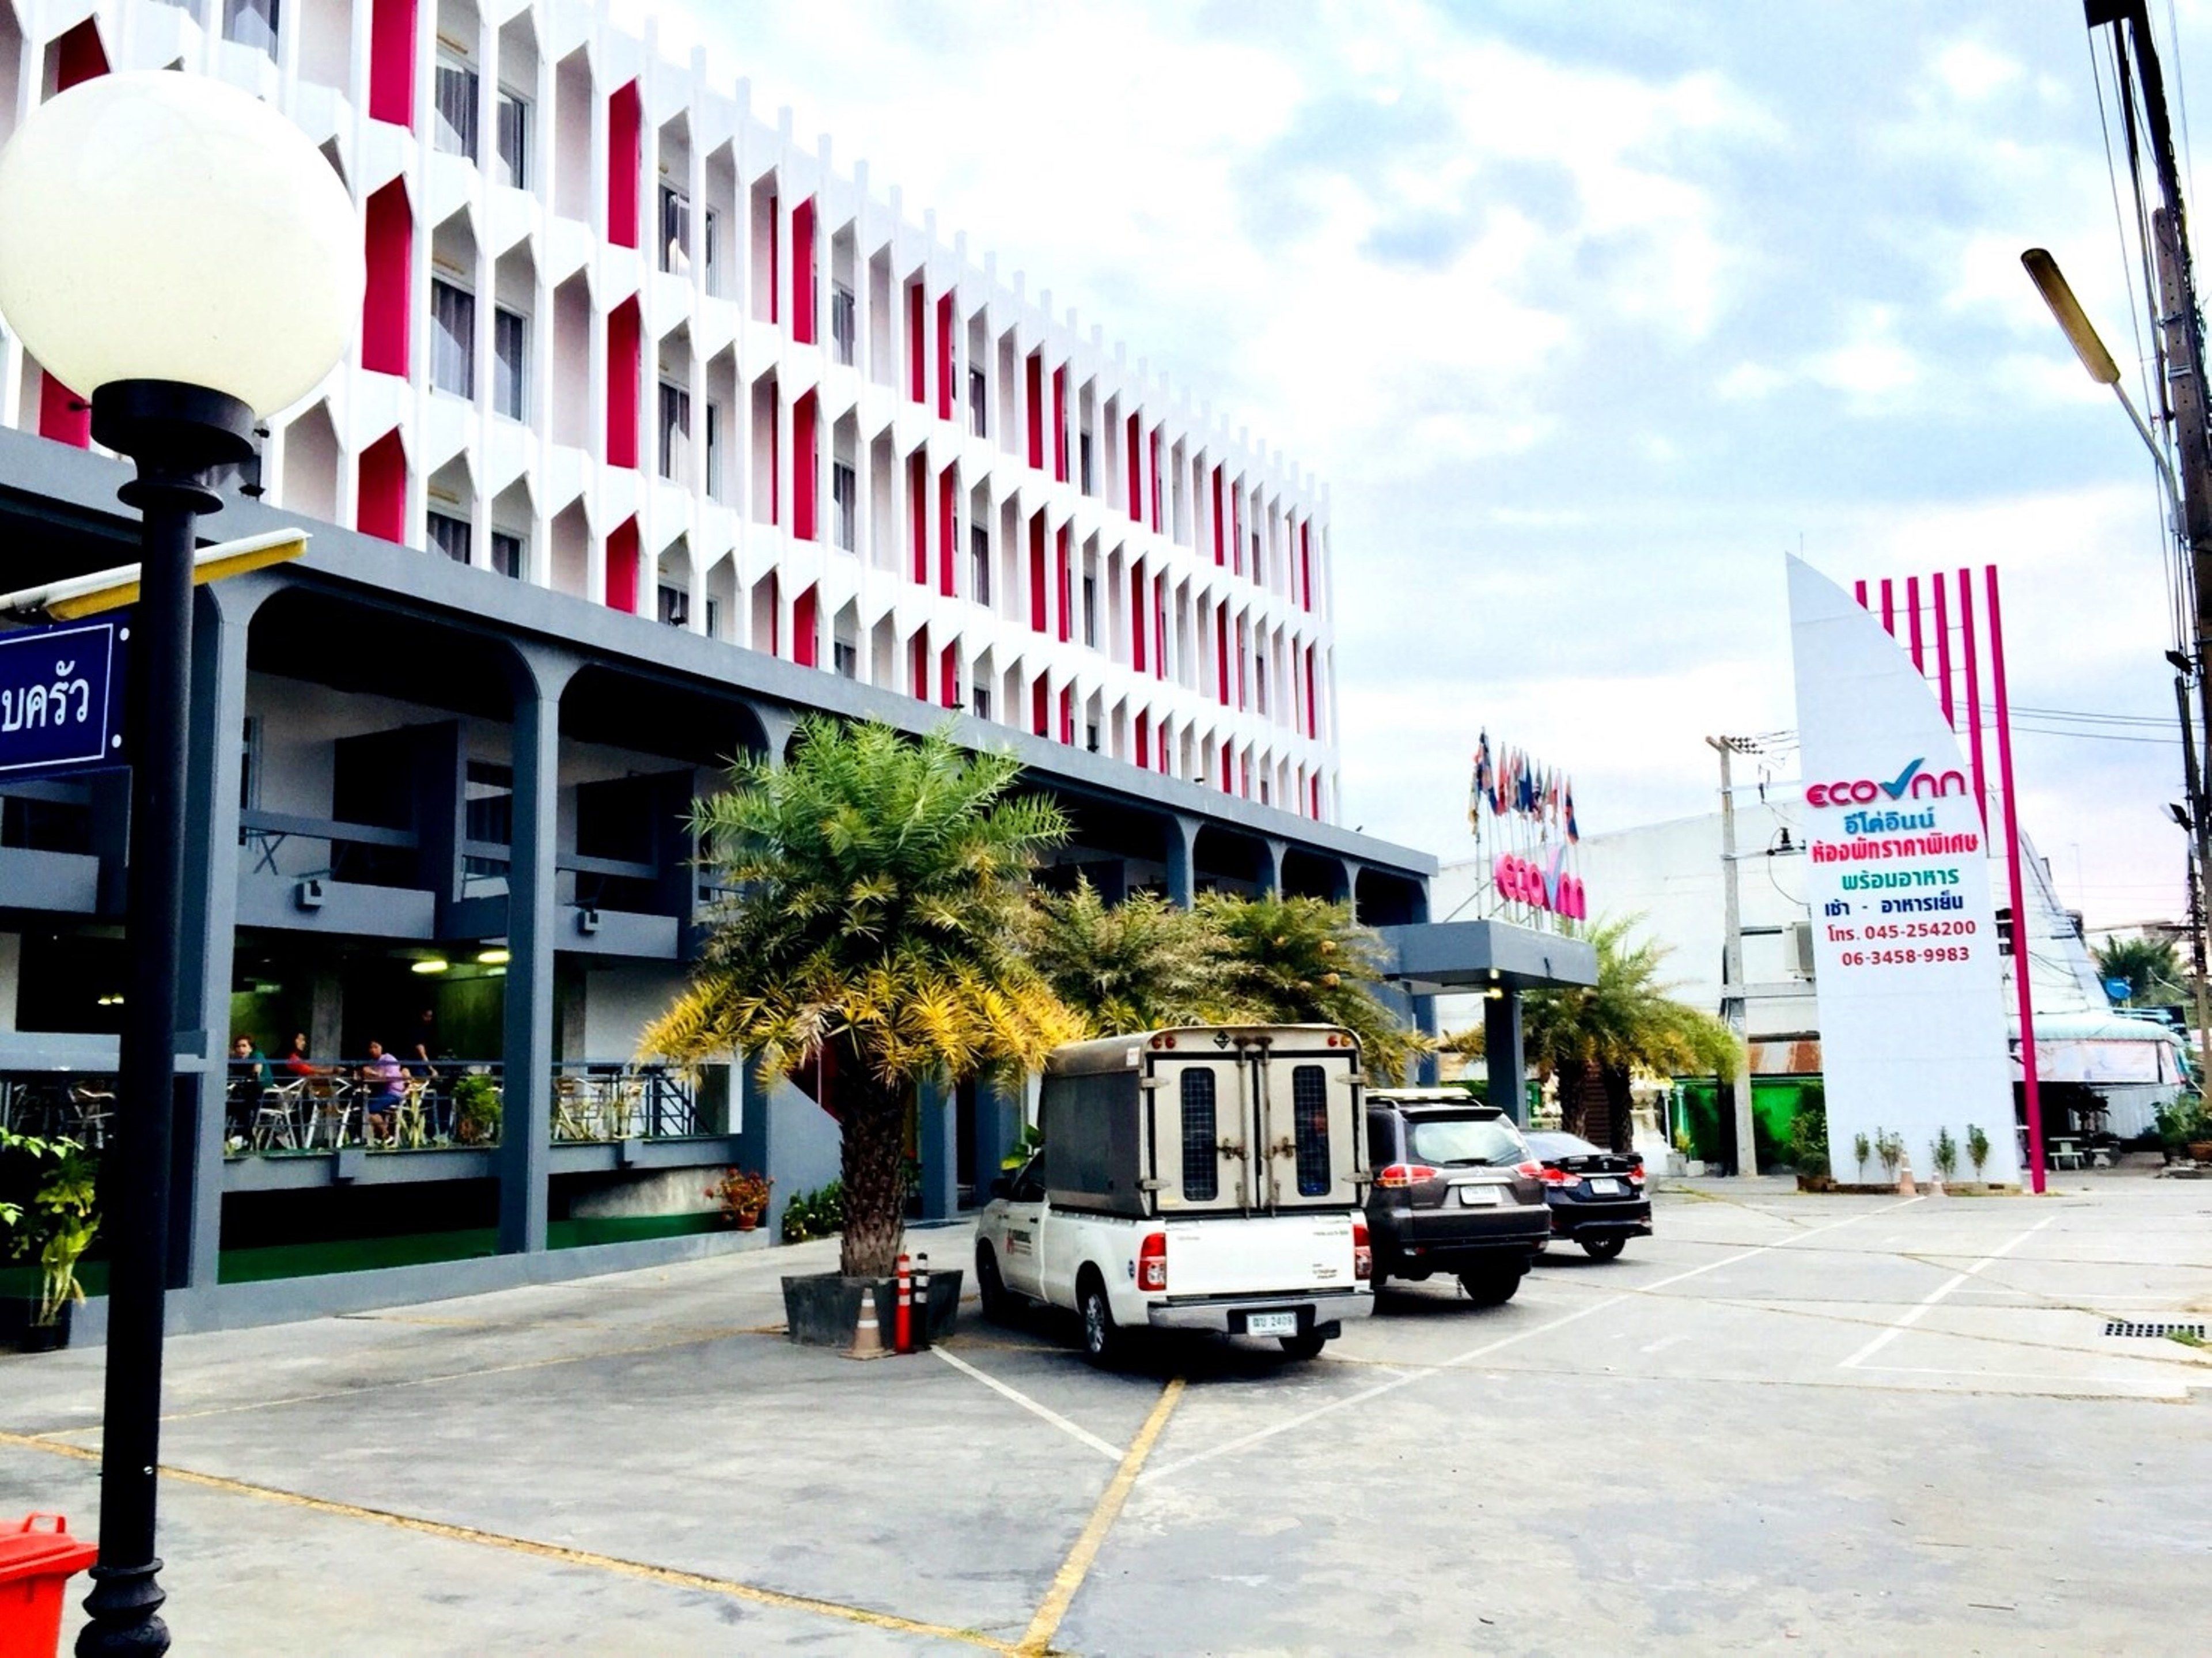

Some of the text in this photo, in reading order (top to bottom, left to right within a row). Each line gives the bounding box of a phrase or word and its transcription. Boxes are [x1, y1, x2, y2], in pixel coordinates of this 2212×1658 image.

[1813, 832, 1978, 862] ห้องพักราคาพิเศษ
[1842, 869, 1959, 890] พร้อมอาหาร
[1825, 899, 1850, 916] เช้า
[1881, 890, 1963, 913] อาหารเย็น
[1827, 921, 1976, 941] โทร. 045-254200
[1842, 947, 1969, 966] 06-3458-9983
